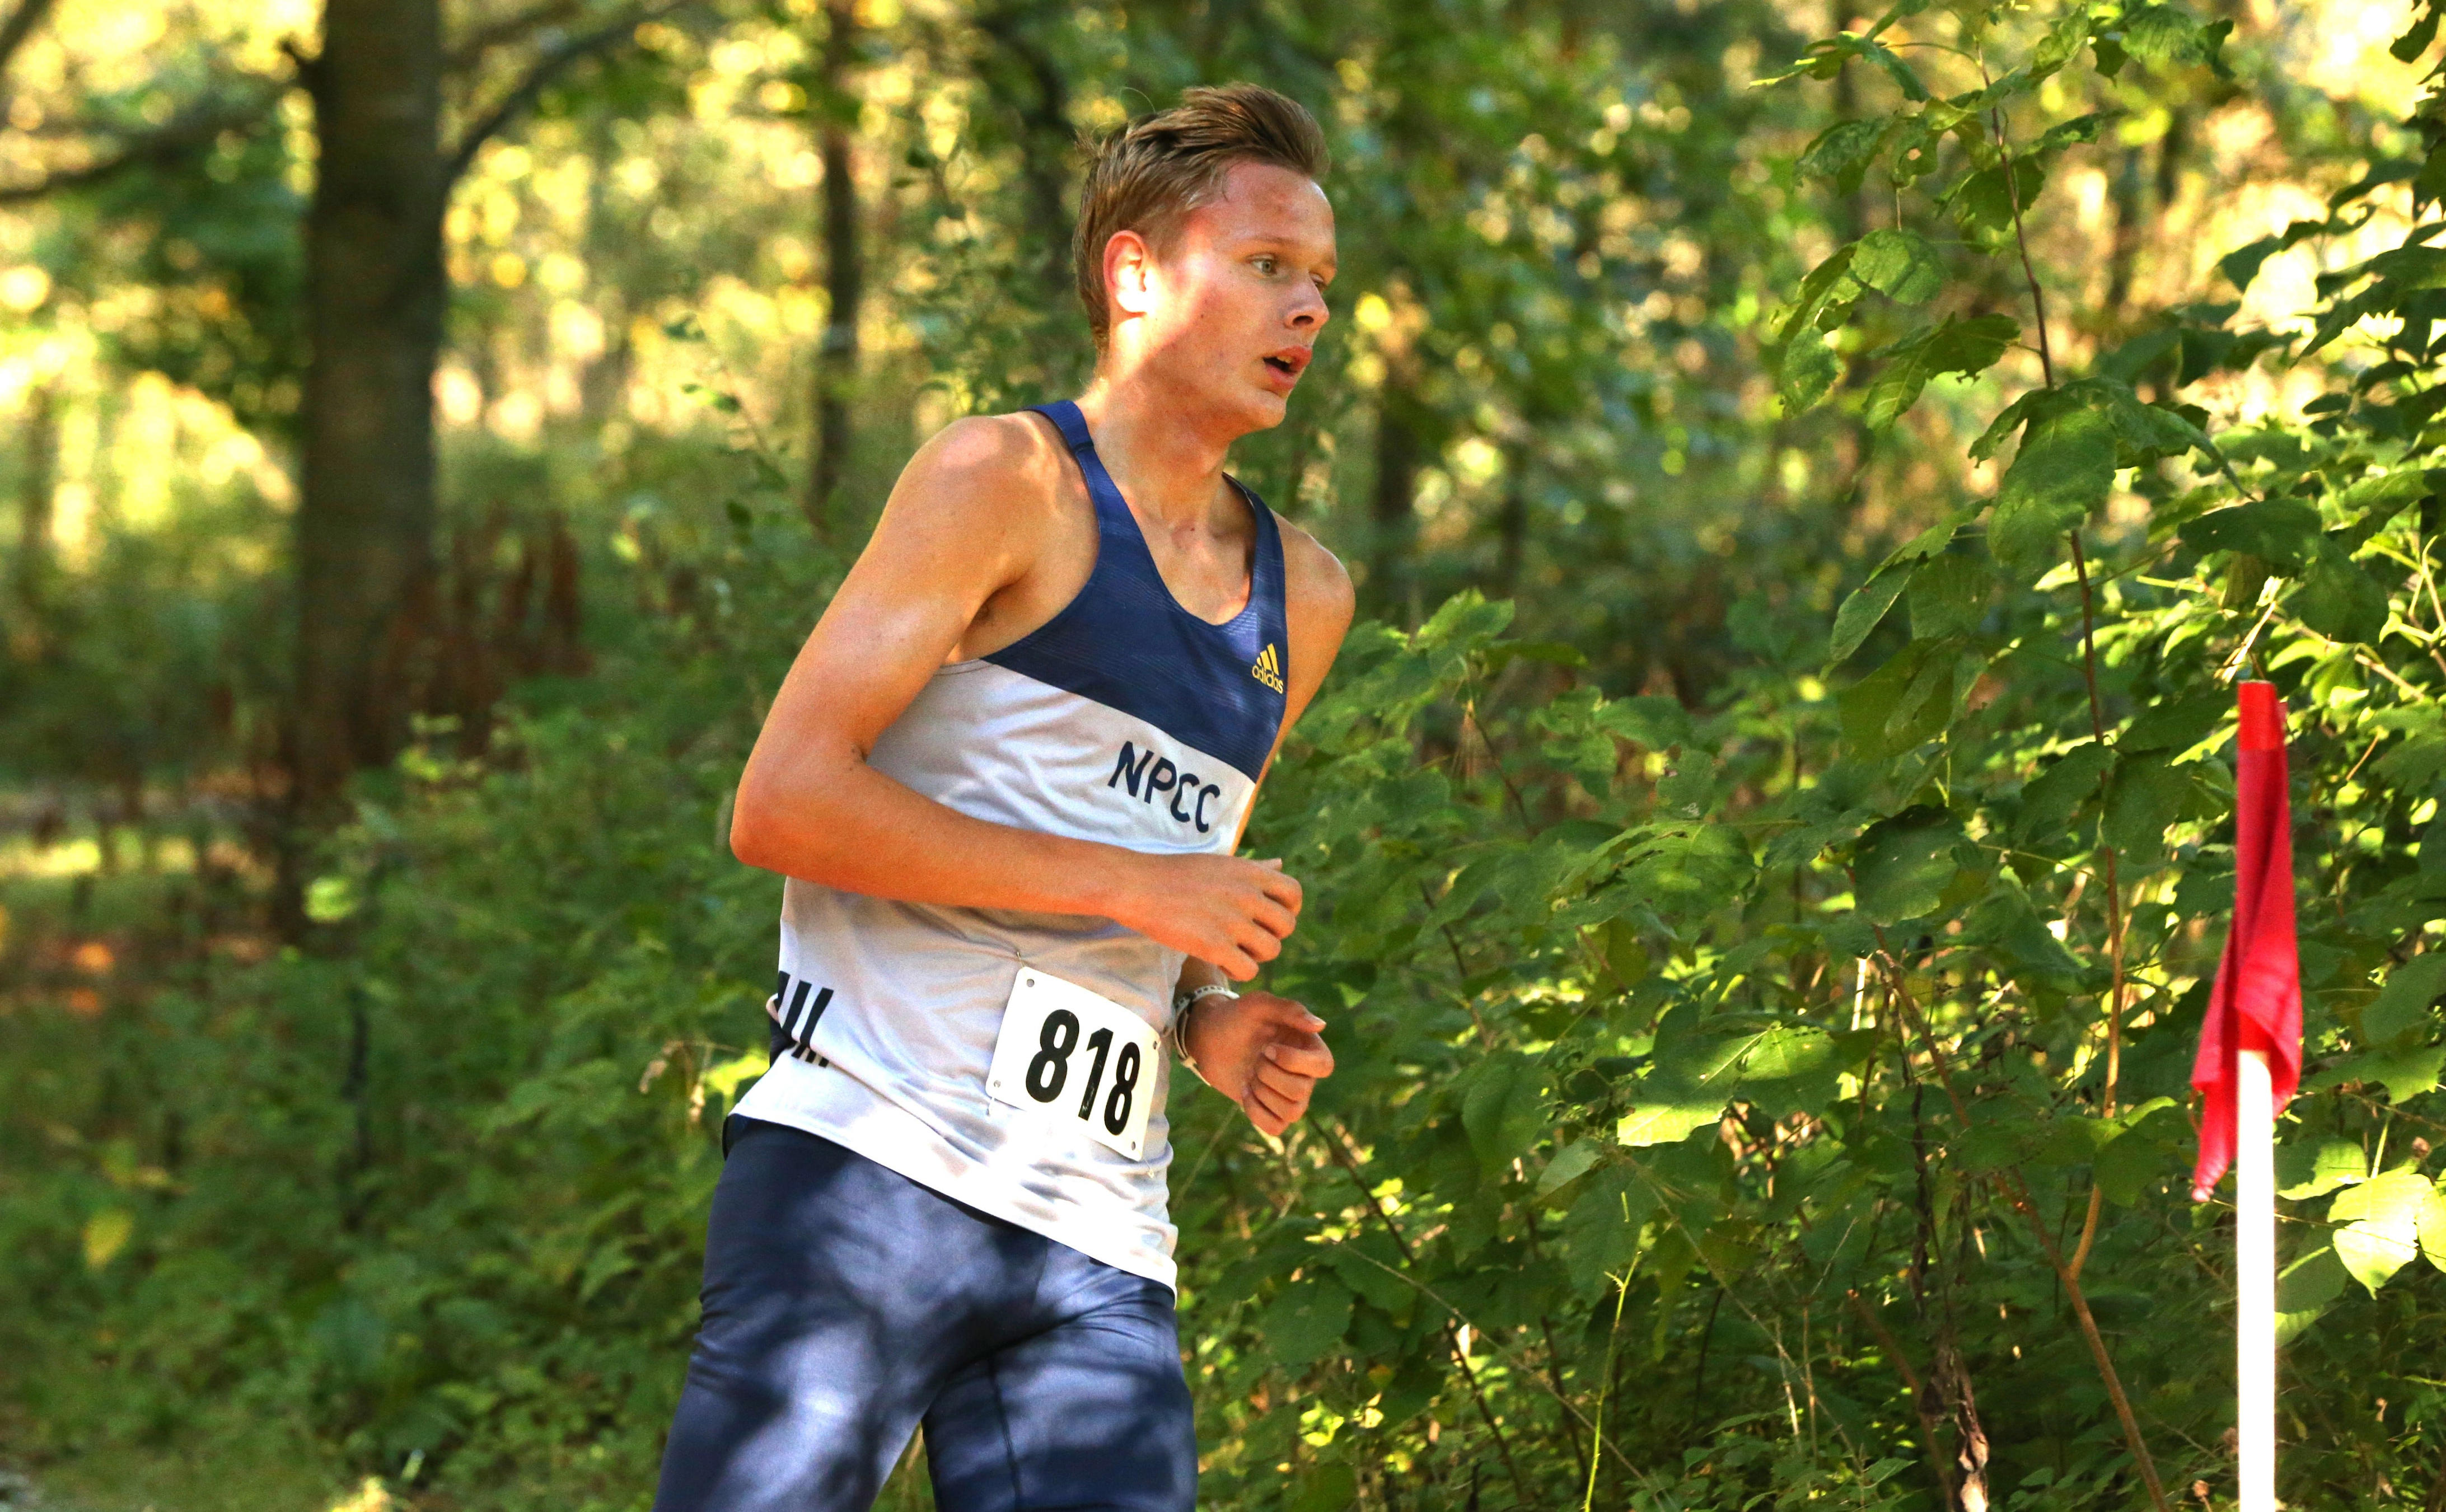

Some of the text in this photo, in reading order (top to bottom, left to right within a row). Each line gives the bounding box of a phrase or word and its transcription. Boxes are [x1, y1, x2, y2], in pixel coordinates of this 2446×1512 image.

[1252, 664, 1284, 694] adidas
[1107, 741, 1220, 833] NPCC
[1025, 1009, 1140, 1136] 818
